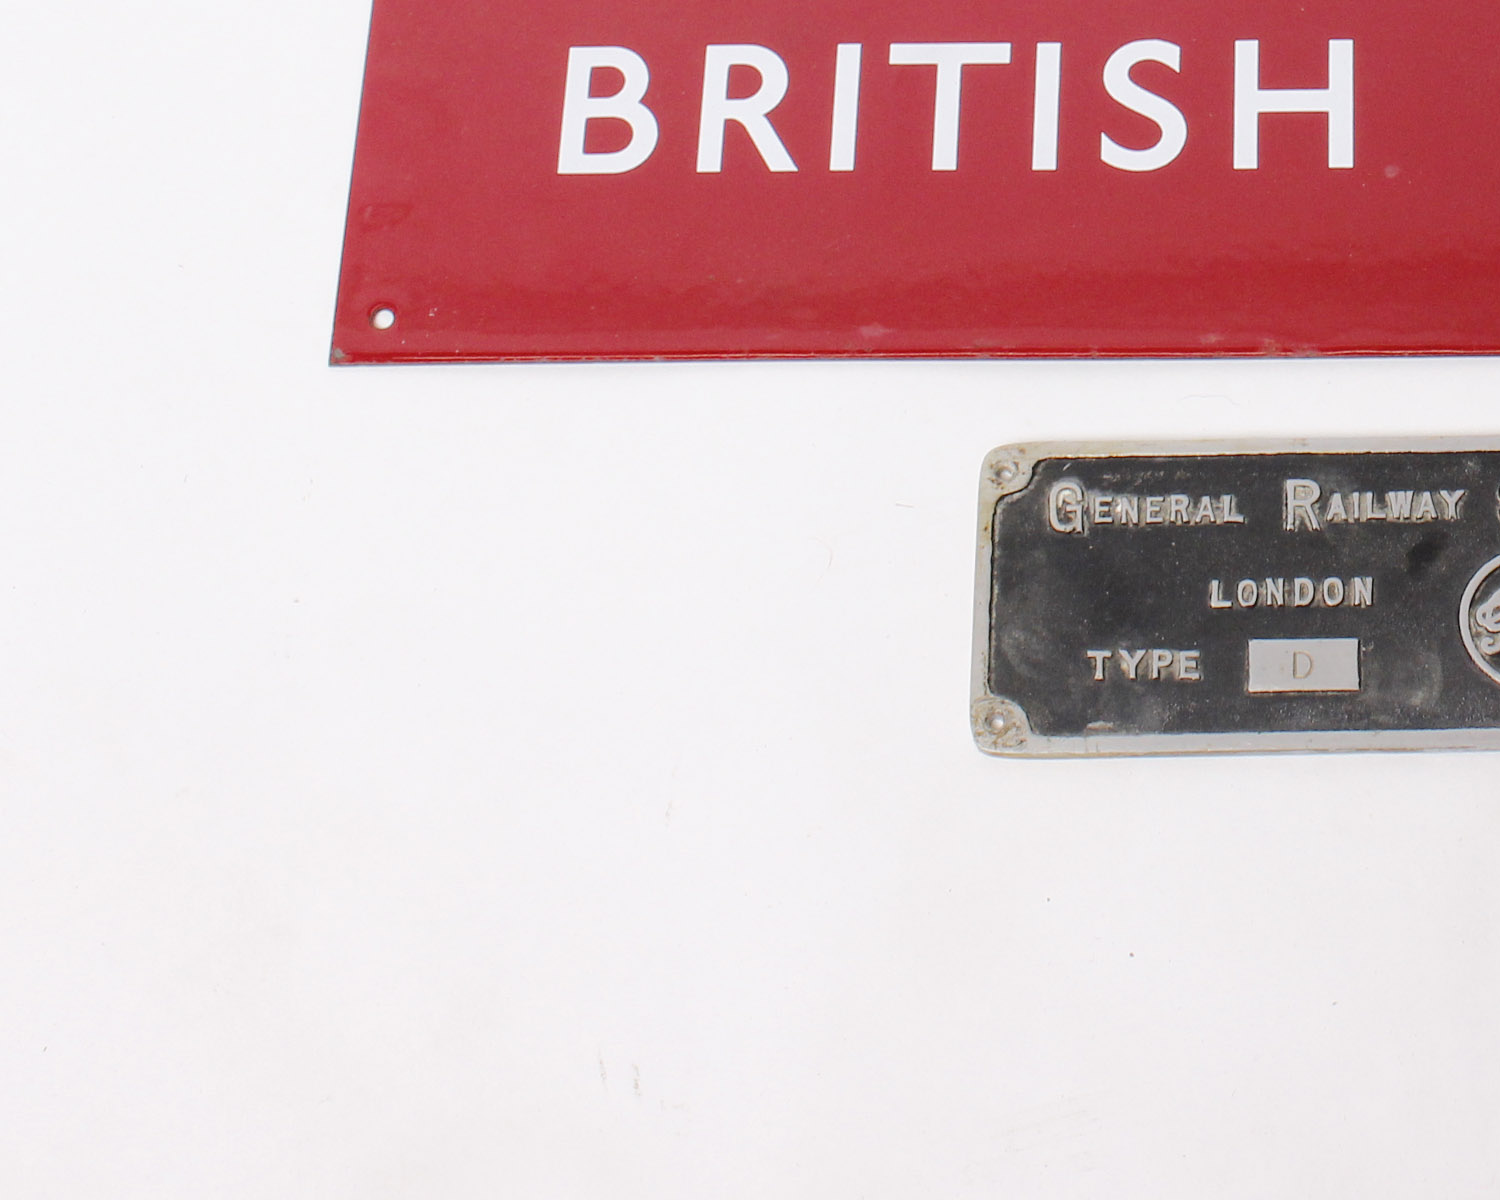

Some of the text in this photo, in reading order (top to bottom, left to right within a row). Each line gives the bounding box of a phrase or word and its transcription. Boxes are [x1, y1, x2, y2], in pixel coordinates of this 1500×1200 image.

[556, 39, 1355, 176] BRITISH
[1209, 575, 1374, 609] LONDON
[1086, 647, 1314, 681] TYPE D
